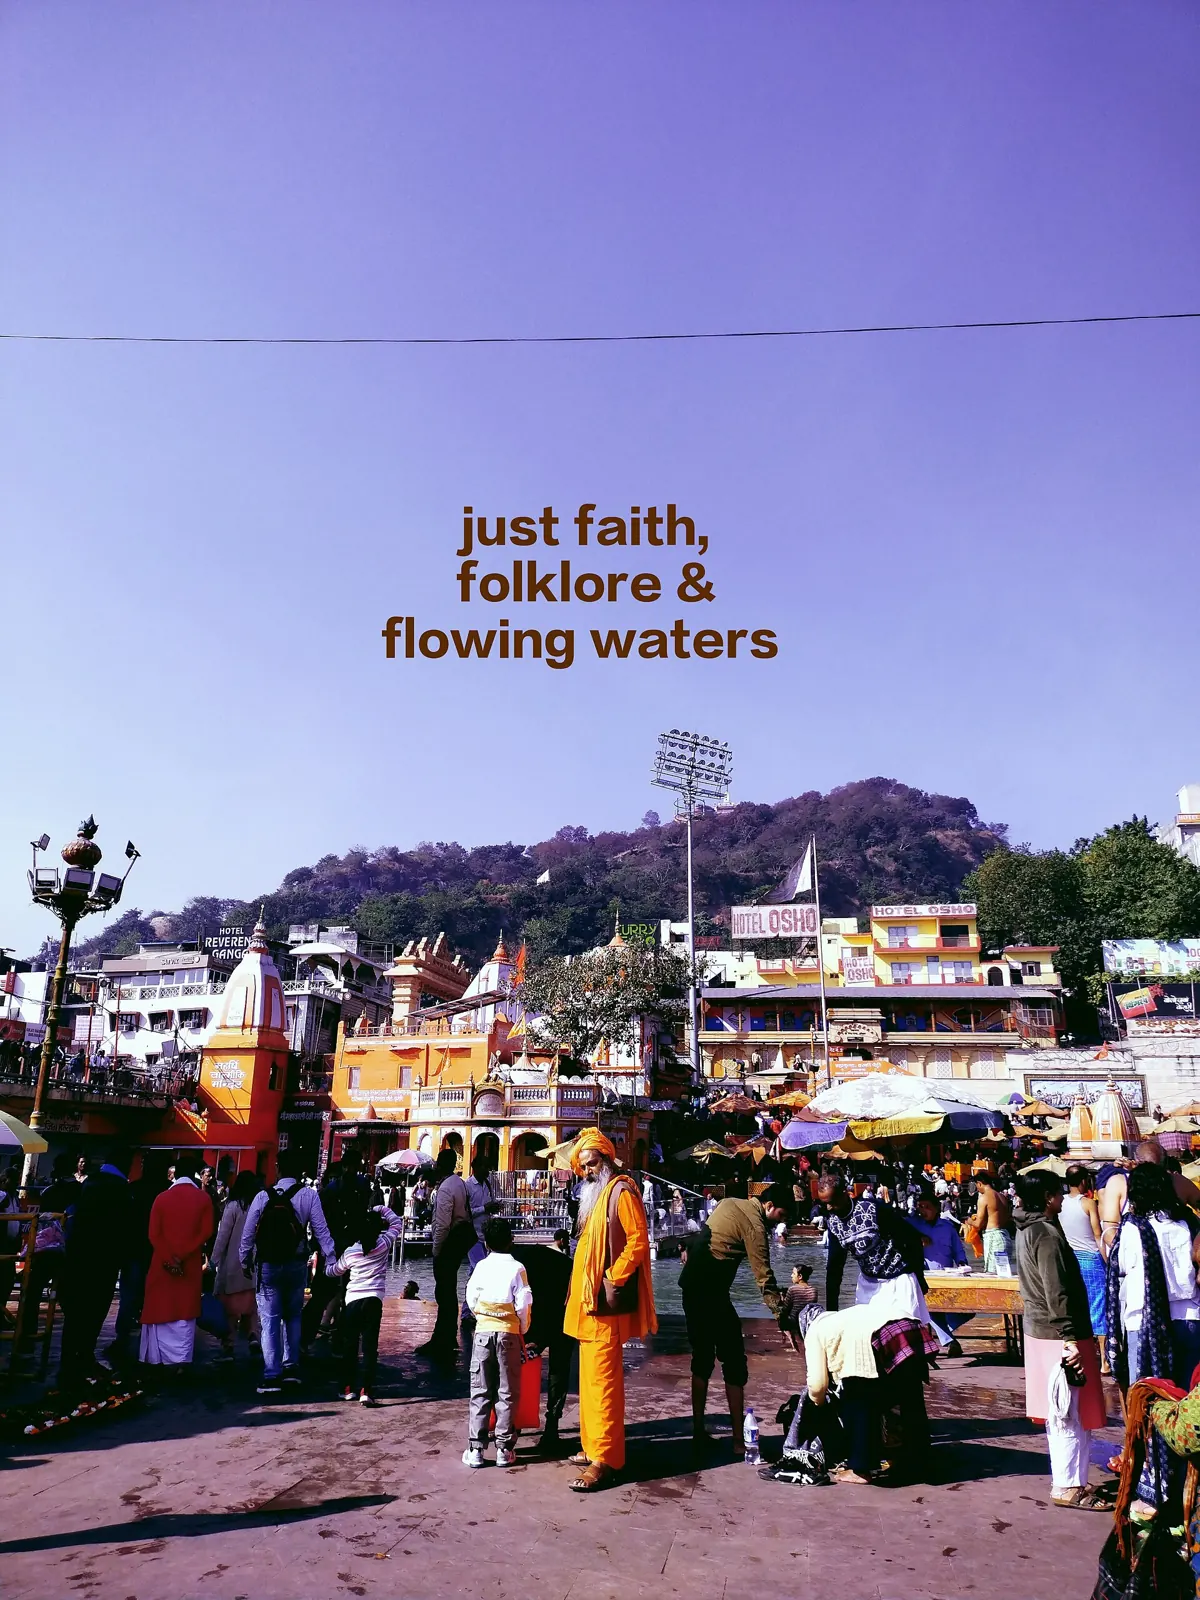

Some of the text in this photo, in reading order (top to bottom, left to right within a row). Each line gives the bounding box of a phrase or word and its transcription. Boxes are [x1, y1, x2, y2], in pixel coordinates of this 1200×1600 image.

[875, 905, 975, 916] HOTEL OSHO
[733, 908, 817, 934] HOTEL OSHO
[219, 927, 245, 935] HOTEL
[846, 957, 874, 968] HOTEL
